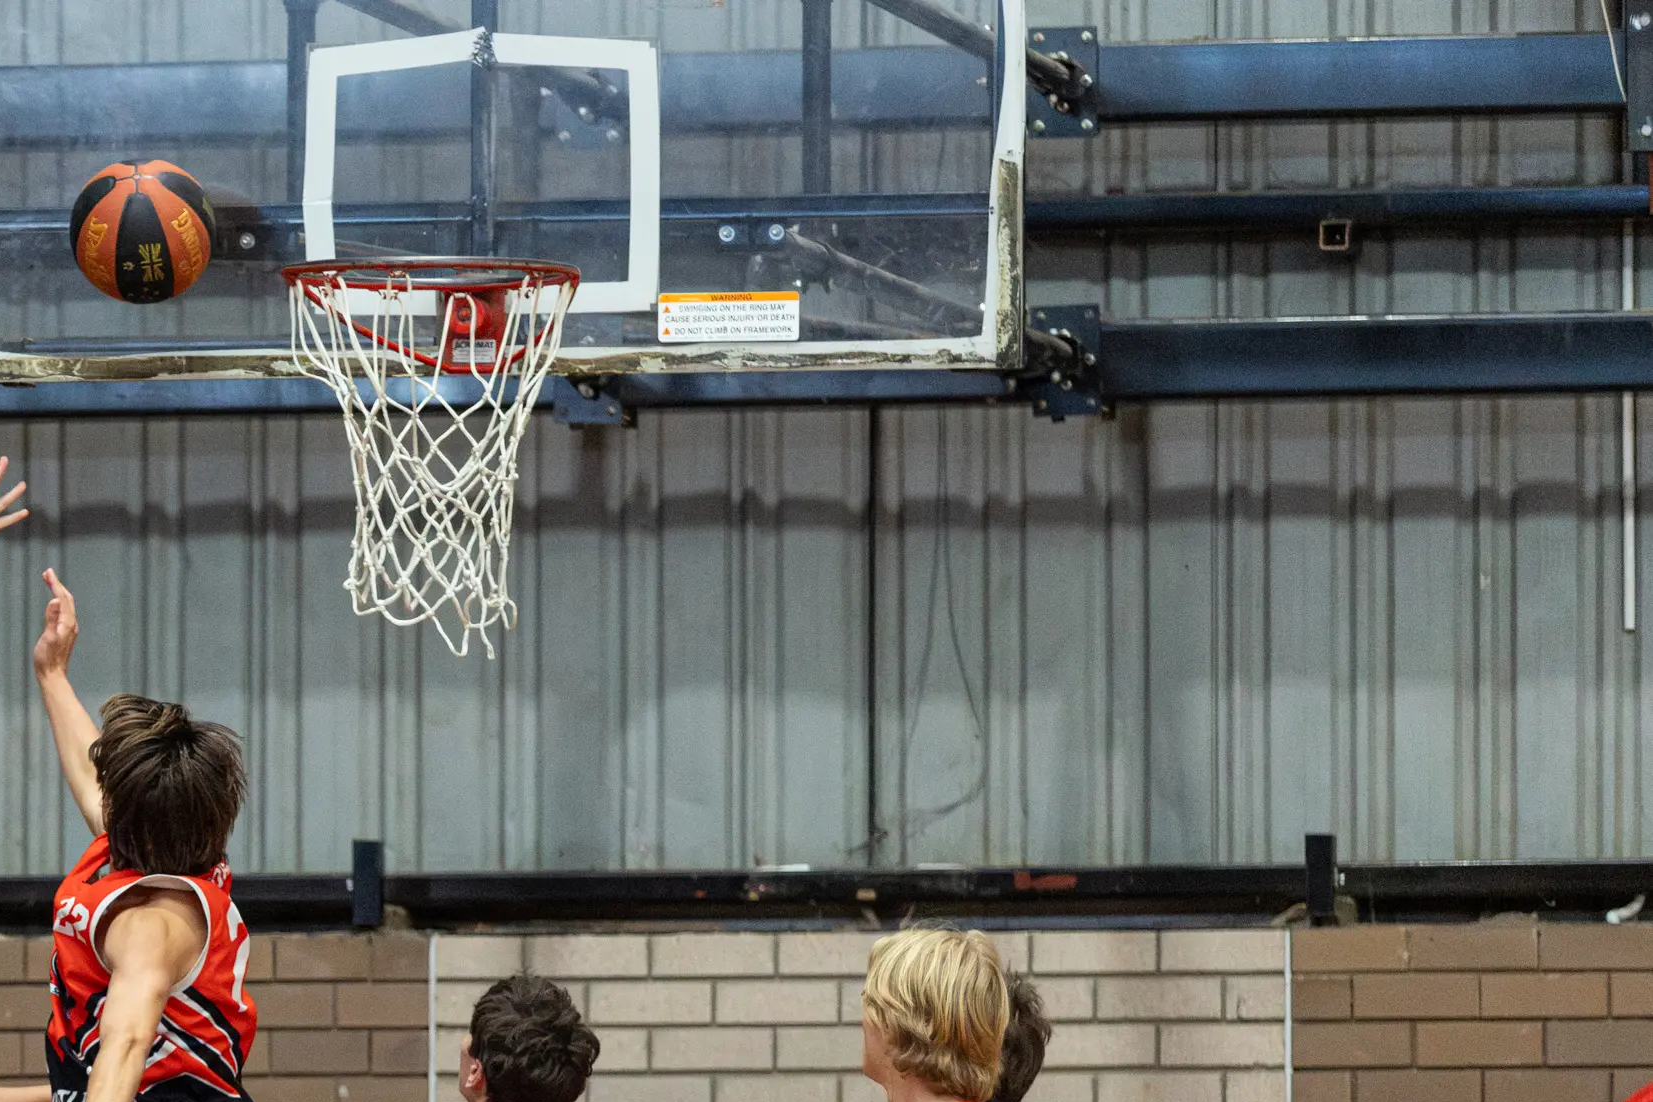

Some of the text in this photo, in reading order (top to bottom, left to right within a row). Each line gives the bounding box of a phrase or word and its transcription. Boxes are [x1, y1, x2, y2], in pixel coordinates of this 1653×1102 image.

[710, 293, 753, 301] WARNING
[678, 303, 786, 313] SWINGING ON THE RING MAY
[664, 313, 795, 323] CAUSE SERIOUS INJURY OR DEATH
[674, 327, 686, 335] DO
[687, 327, 703, 335] NOT
[704, 326, 728, 334] CLIMB
[730, 326, 742, 334] ON
